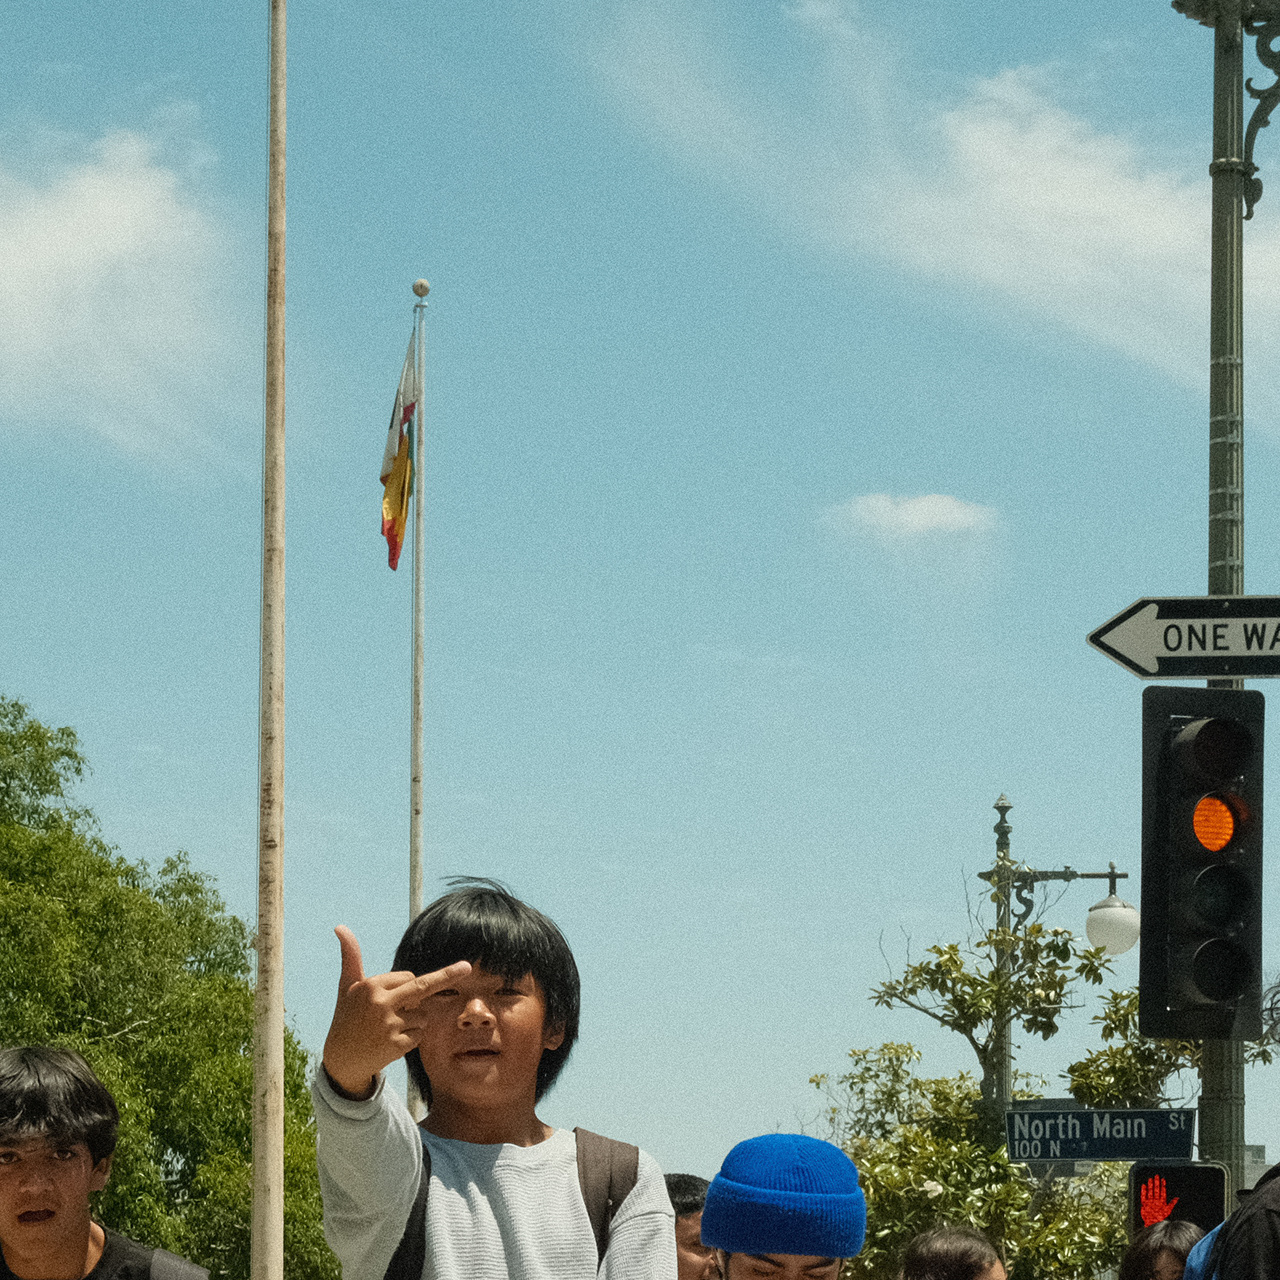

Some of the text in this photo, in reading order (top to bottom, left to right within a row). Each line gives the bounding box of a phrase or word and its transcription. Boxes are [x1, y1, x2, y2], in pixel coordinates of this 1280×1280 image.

[1163, 623, 1230, 652] ONE
[1013, 1112, 1186, 1140] North Main St
[1014, 1140, 1061, 1158] 100 N
